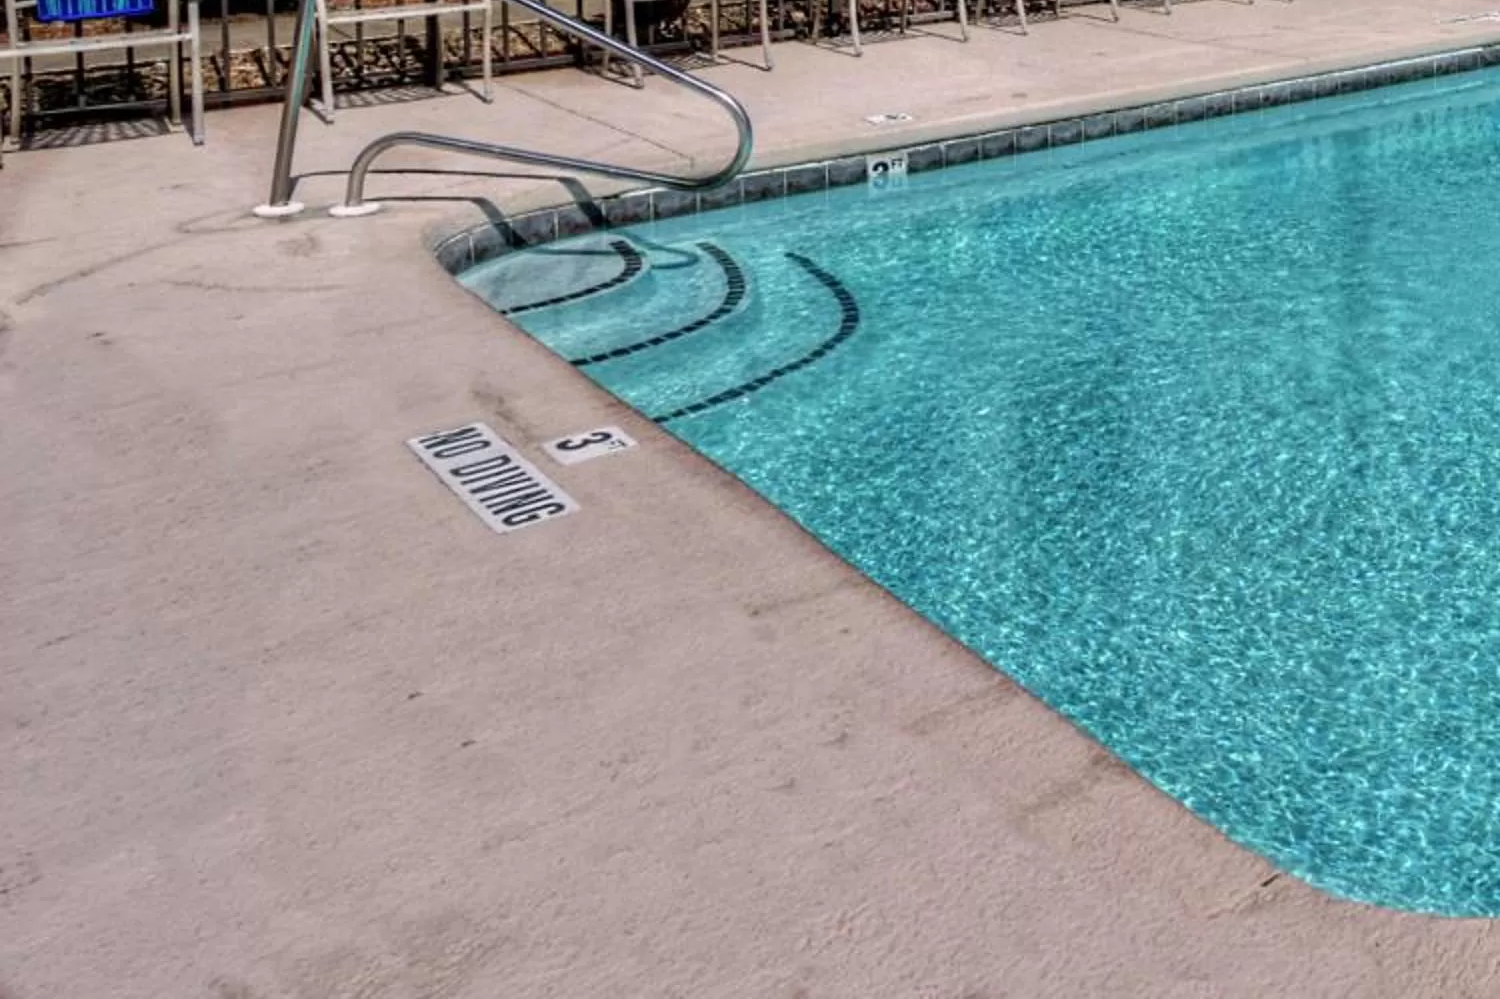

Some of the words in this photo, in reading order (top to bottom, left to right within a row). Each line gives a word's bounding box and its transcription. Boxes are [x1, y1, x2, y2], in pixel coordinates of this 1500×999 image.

[417, 427, 492, 459] NO
[555, 431, 612, 451] 3
[450, 454, 566, 527] DIVING
